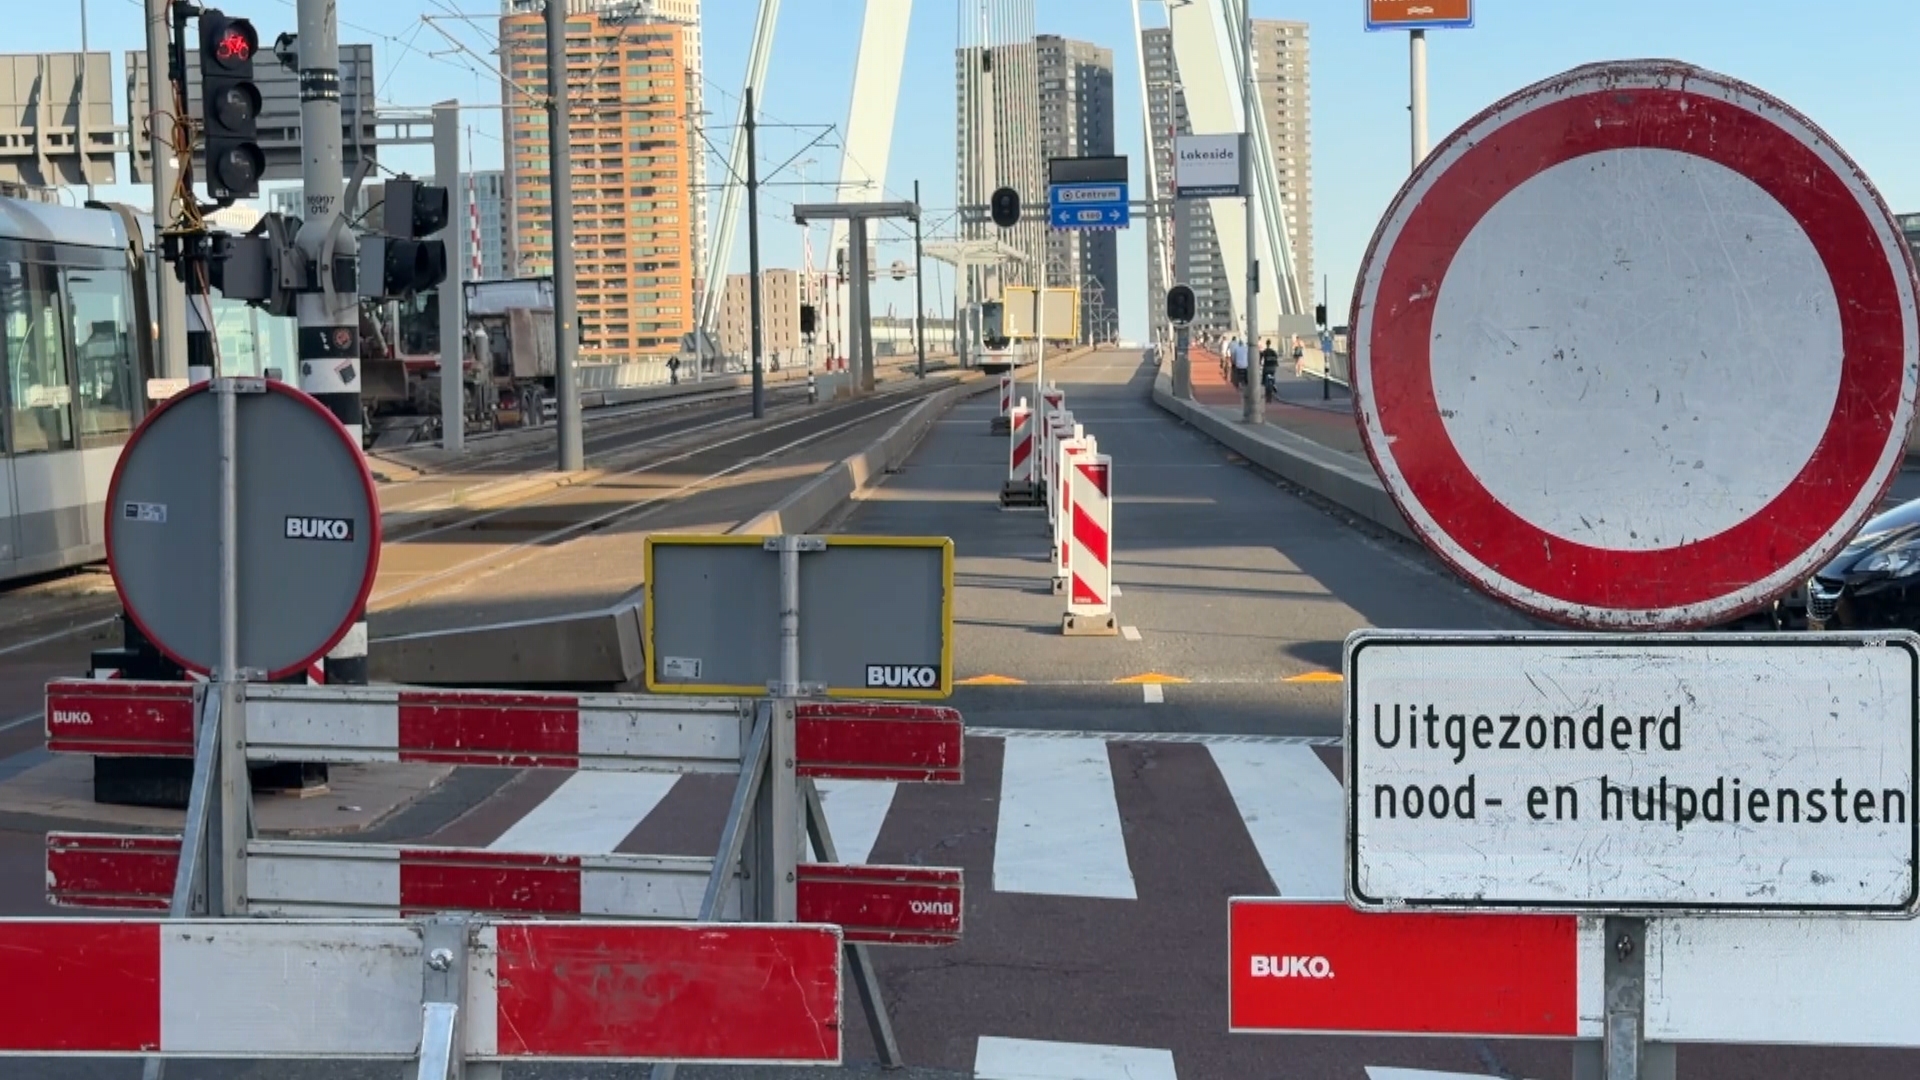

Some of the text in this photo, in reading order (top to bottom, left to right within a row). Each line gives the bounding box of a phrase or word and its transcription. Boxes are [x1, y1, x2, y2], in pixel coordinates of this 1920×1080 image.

[1181, 148, 1234, 160] Lakeside
[1075, 190, 1117, 199] Centrum
[1374, 704, 1681, 765] Uitgezonderd
[1374, 774, 1905, 831] nood- en hulpdiensten
[1251, 955, 1335, 979] BUKO.
